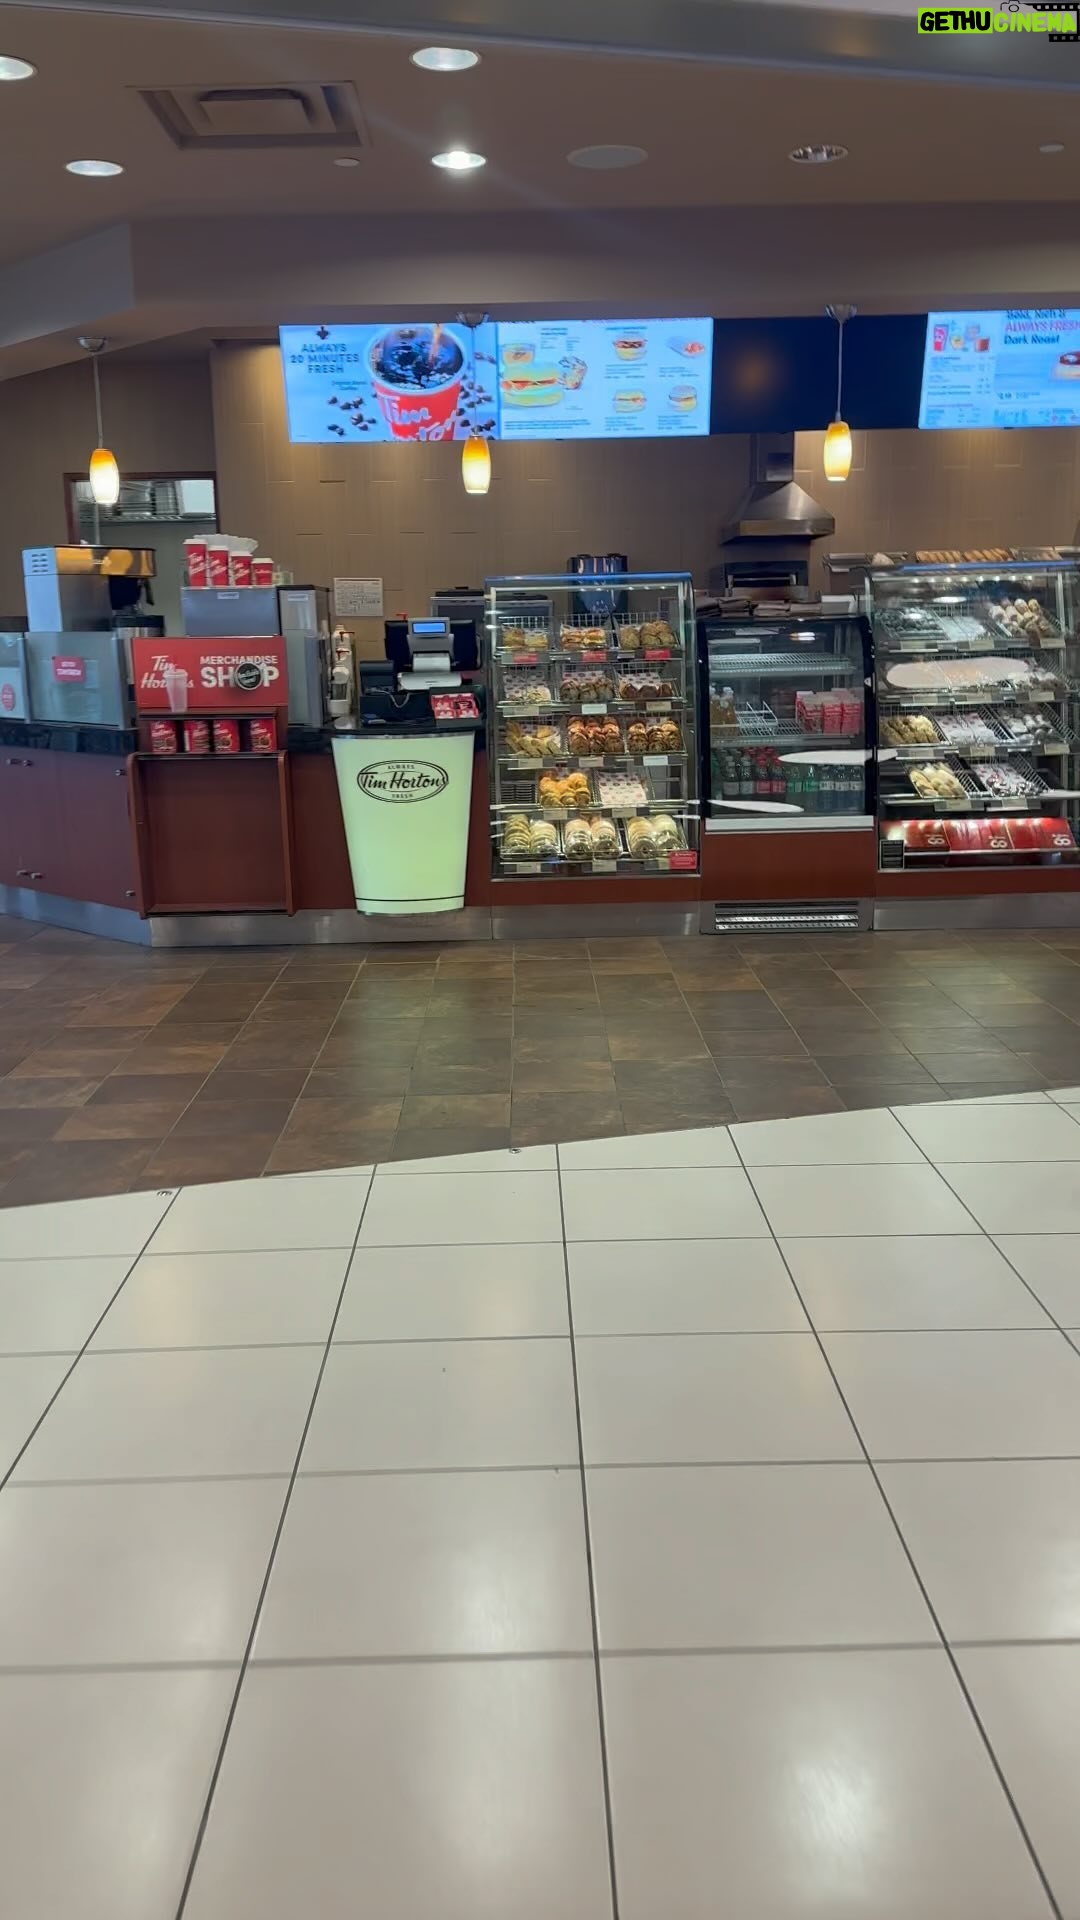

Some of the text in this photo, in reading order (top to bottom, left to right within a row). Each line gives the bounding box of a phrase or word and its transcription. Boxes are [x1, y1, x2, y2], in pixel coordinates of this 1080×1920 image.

[301, 344, 347, 352] ALWAYS
[290, 354, 359, 363] 20 MINUTES
[307, 365, 344, 373] FRESH
[200, 655, 279, 665] MERCHANDISE
[360, 771, 448, 790] Tim Hortons
